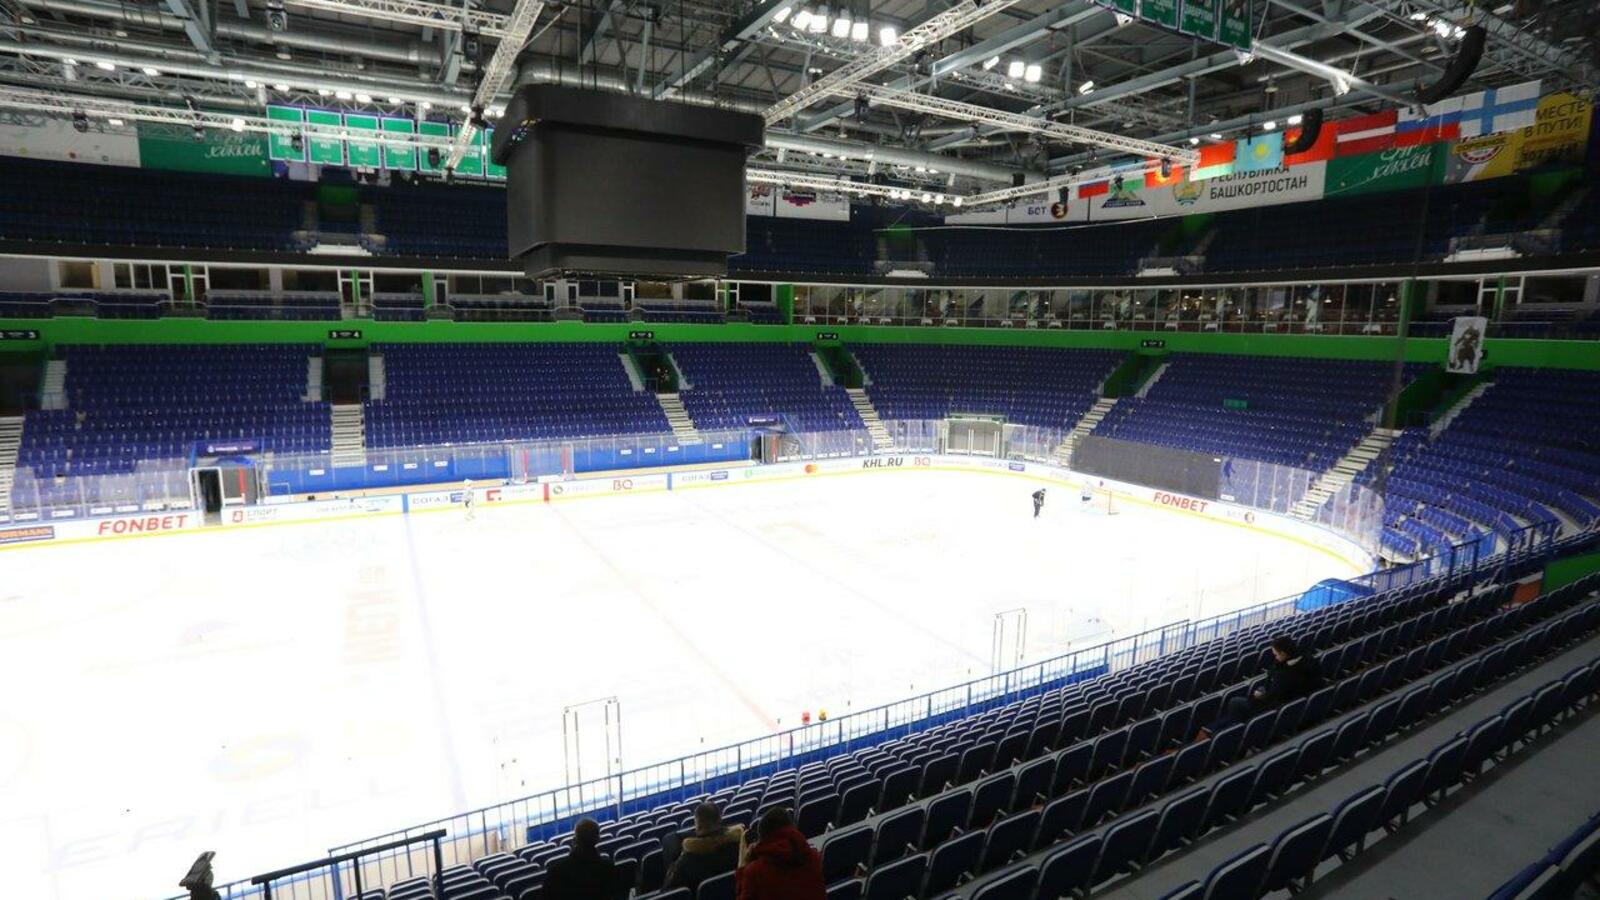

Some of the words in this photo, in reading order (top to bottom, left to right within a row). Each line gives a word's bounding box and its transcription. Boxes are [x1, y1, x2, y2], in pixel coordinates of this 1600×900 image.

[1536, 100, 1585, 120] МЕСТЕ
[1524, 126, 1534, 137] В
[1210, 175, 1307, 200] БАШКОРТОСТАН
[1027, 206, 1047, 216] БСТ
[862, 457, 904, 469] KHL.RU
[612, 479, 634, 491] BQ
[1153, 491, 1208, 513] FONBET
[98, 514, 188, 536] FONBET
